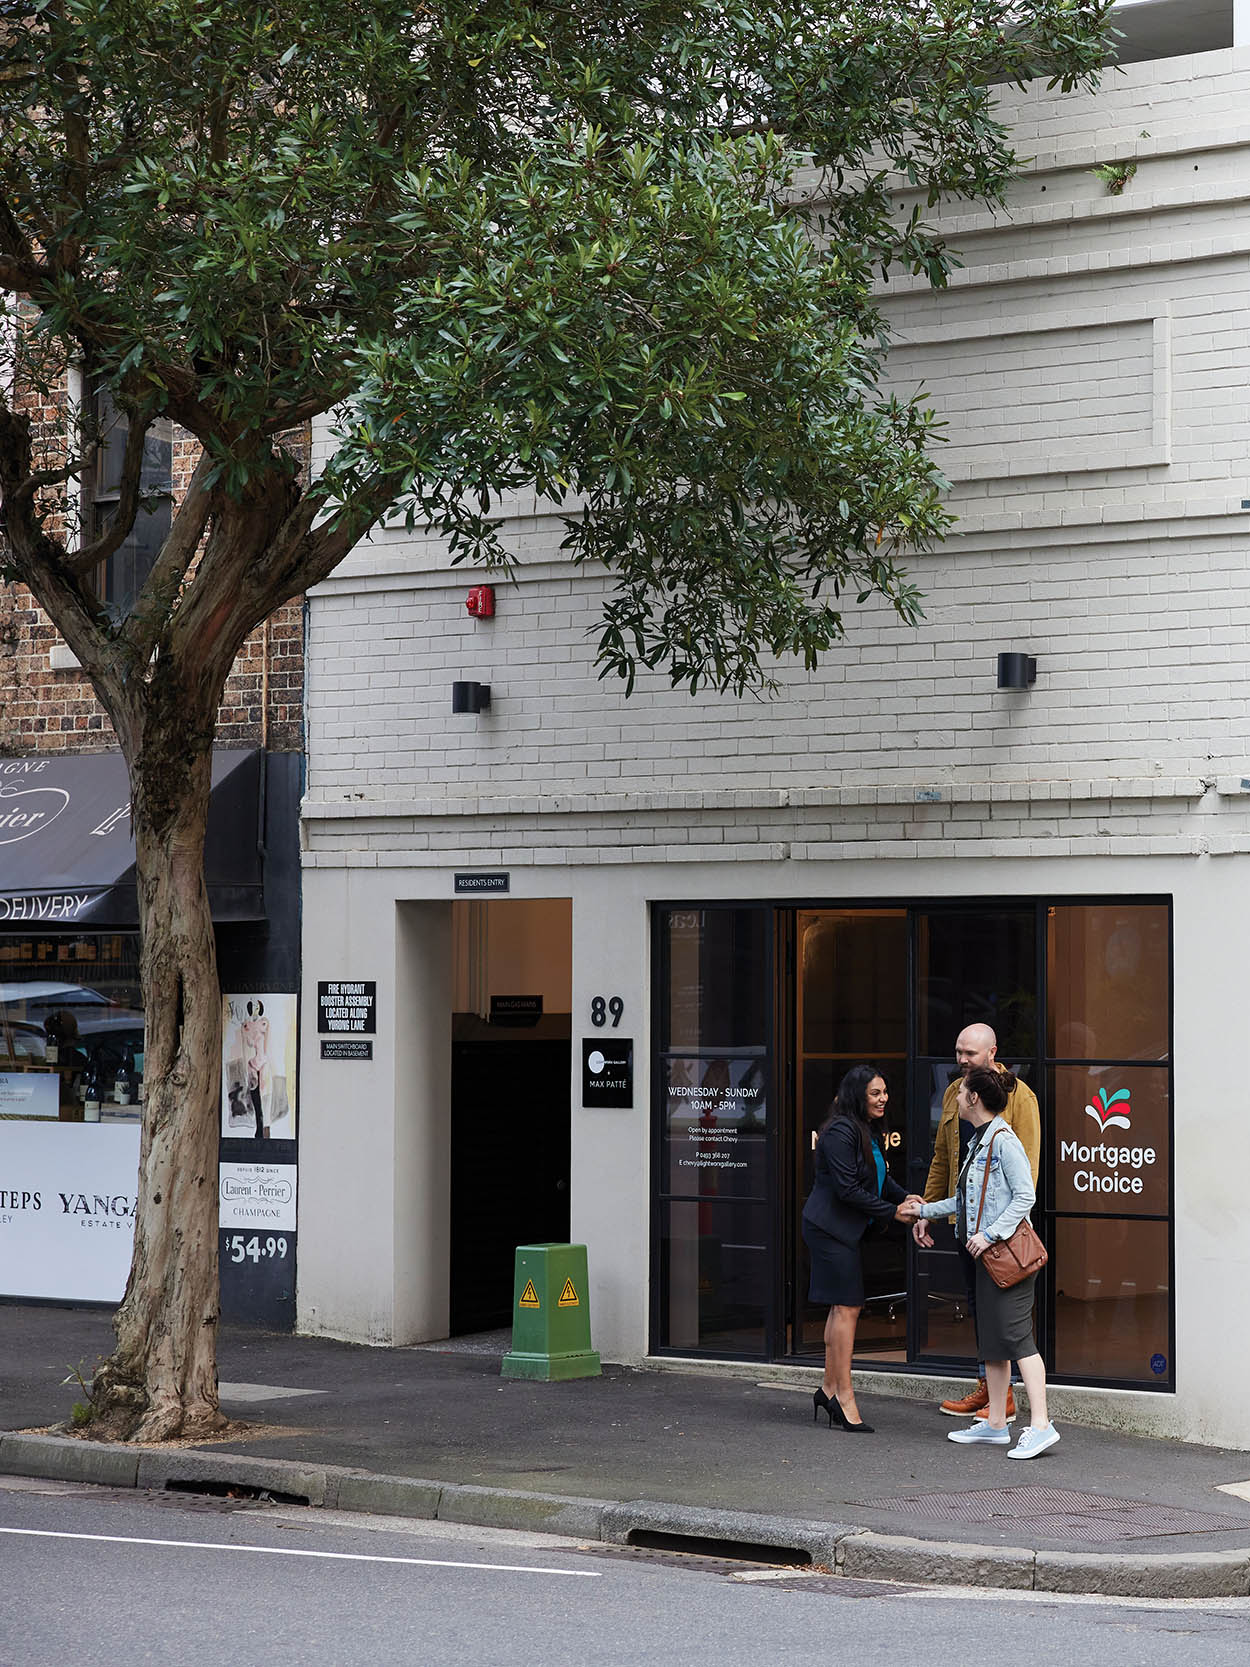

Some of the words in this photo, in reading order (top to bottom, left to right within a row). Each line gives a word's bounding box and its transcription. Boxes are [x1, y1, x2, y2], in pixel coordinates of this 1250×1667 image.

[458, 879, 487, 887] RESIDENTS
[487, 878, 505, 887] ENTRY
[328, 984, 339, 994] FIRE
[340, 984, 365, 994] HYDRANT
[320, 996, 344, 1006] BOOSTER
[345, 996, 373, 1006] ASSEMBLY
[325, 1007, 348, 1018] LOCATED
[350, 1008, 367, 1018] ALONG
[591, 996, 624, 1028] 89
[351, 1020, 365, 1030] LANE
[589, 1080, 605, 1088] MAX
[668, 1087, 718, 1096] WEDNESDAY
[725, 1088, 759, 1097] SUNDAY
[691, 1101, 712, 1110] 10AM
[719, 1101, 736, 1110] 5PM
[1061, 1141, 1156, 1168] Mortgage
[1074, 1170, 1143, 1193] Choice
[225, 1181, 252, 1195] Laurent
[259, 1184, 286, 1197] Perrier
[232, 1208, 281, 1217] CHAMPAGNE
[80, 1220, 121, 1228] ESTATE
[225, 1235, 288, 1263] $54.99
